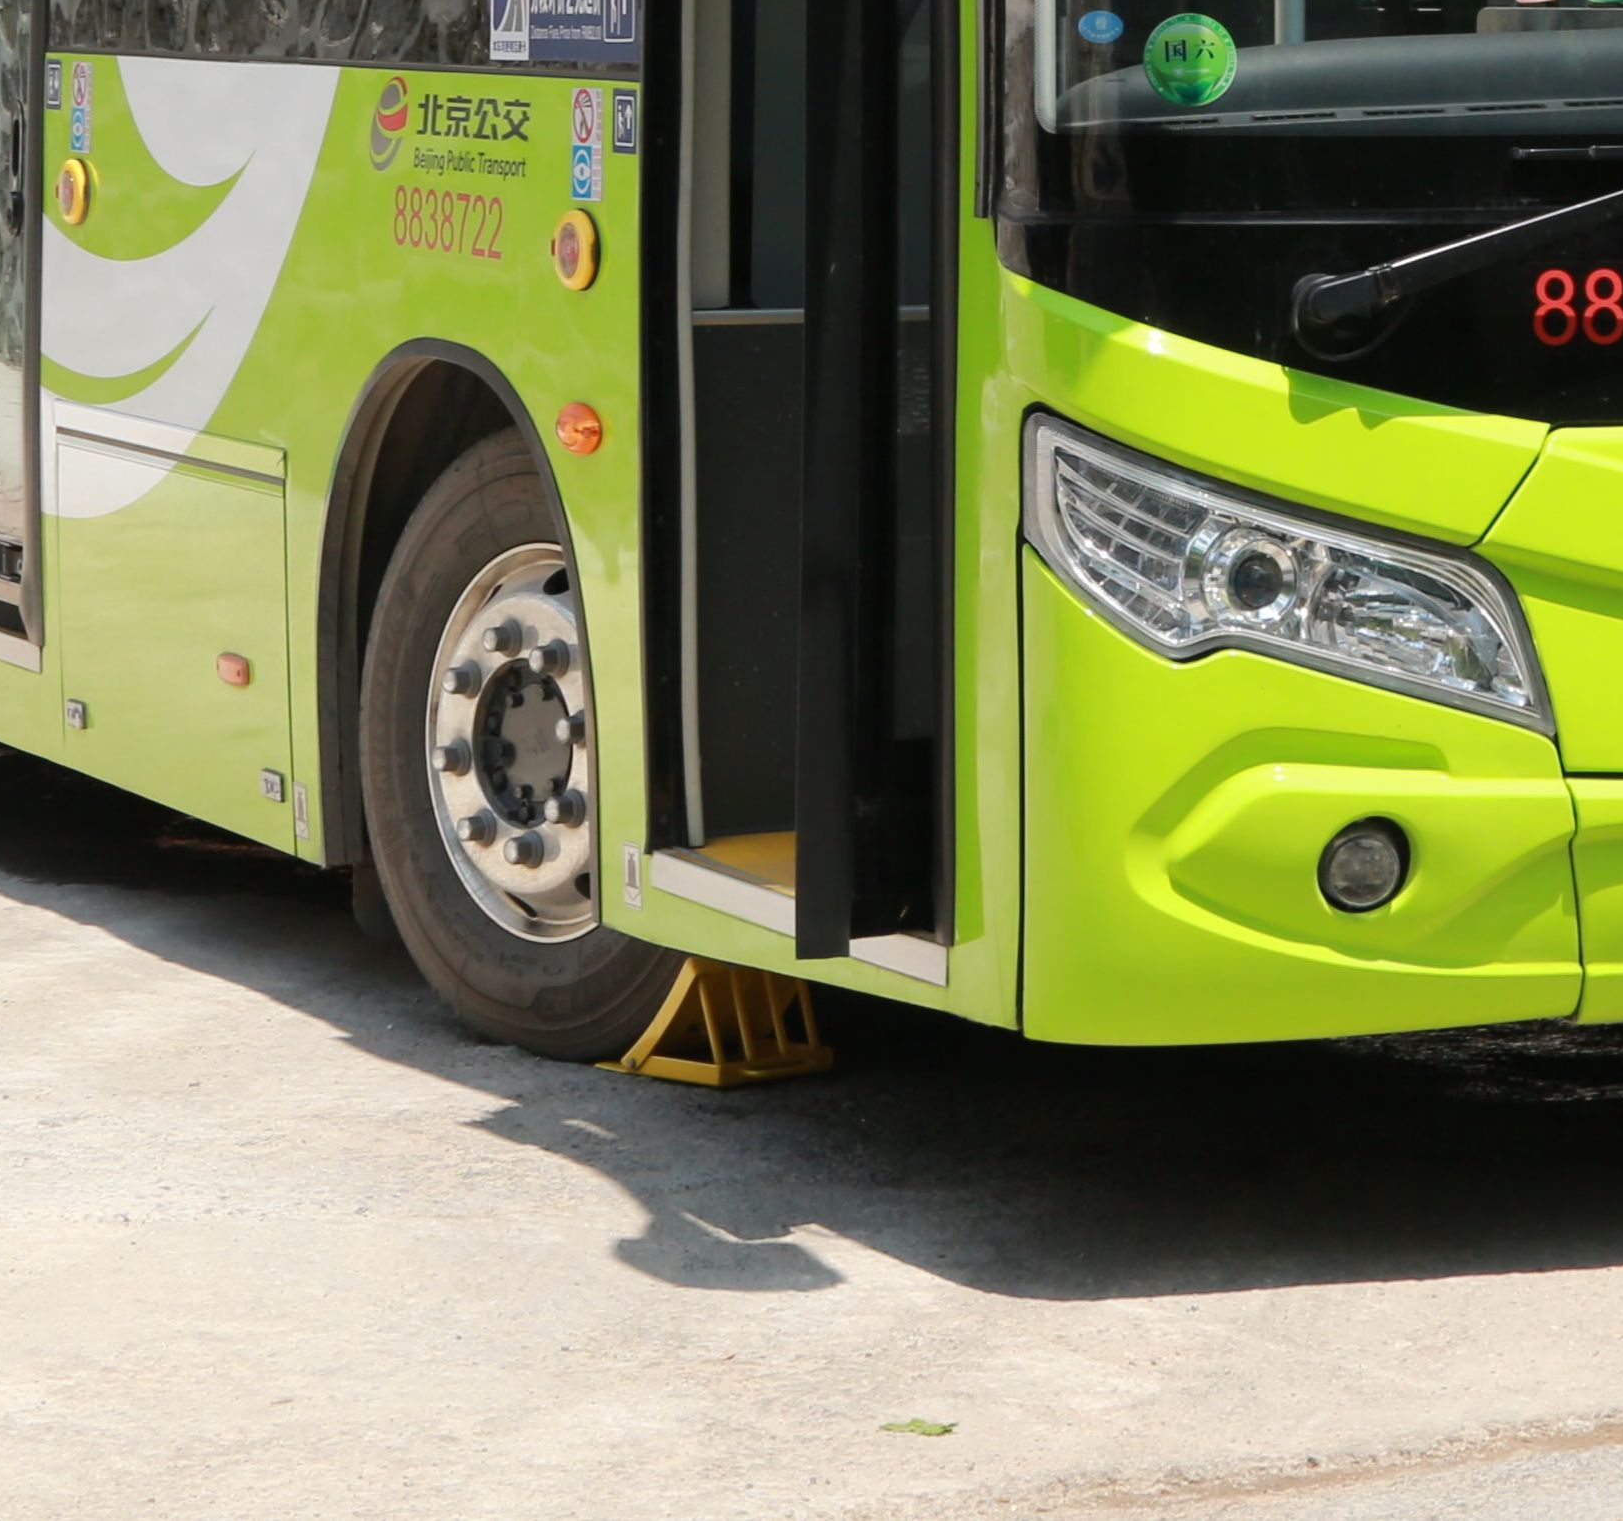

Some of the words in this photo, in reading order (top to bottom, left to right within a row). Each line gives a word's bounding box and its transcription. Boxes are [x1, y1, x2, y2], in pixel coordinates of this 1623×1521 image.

[1164, 39, 1215, 63] 国六
[416, 93, 531, 142] 北京公交
[413, 146, 445, 177] Beijing
[447, 149, 475, 174] Public
[477, 151, 527, 182] Transport
[393, 184, 503, 260] 8838722
